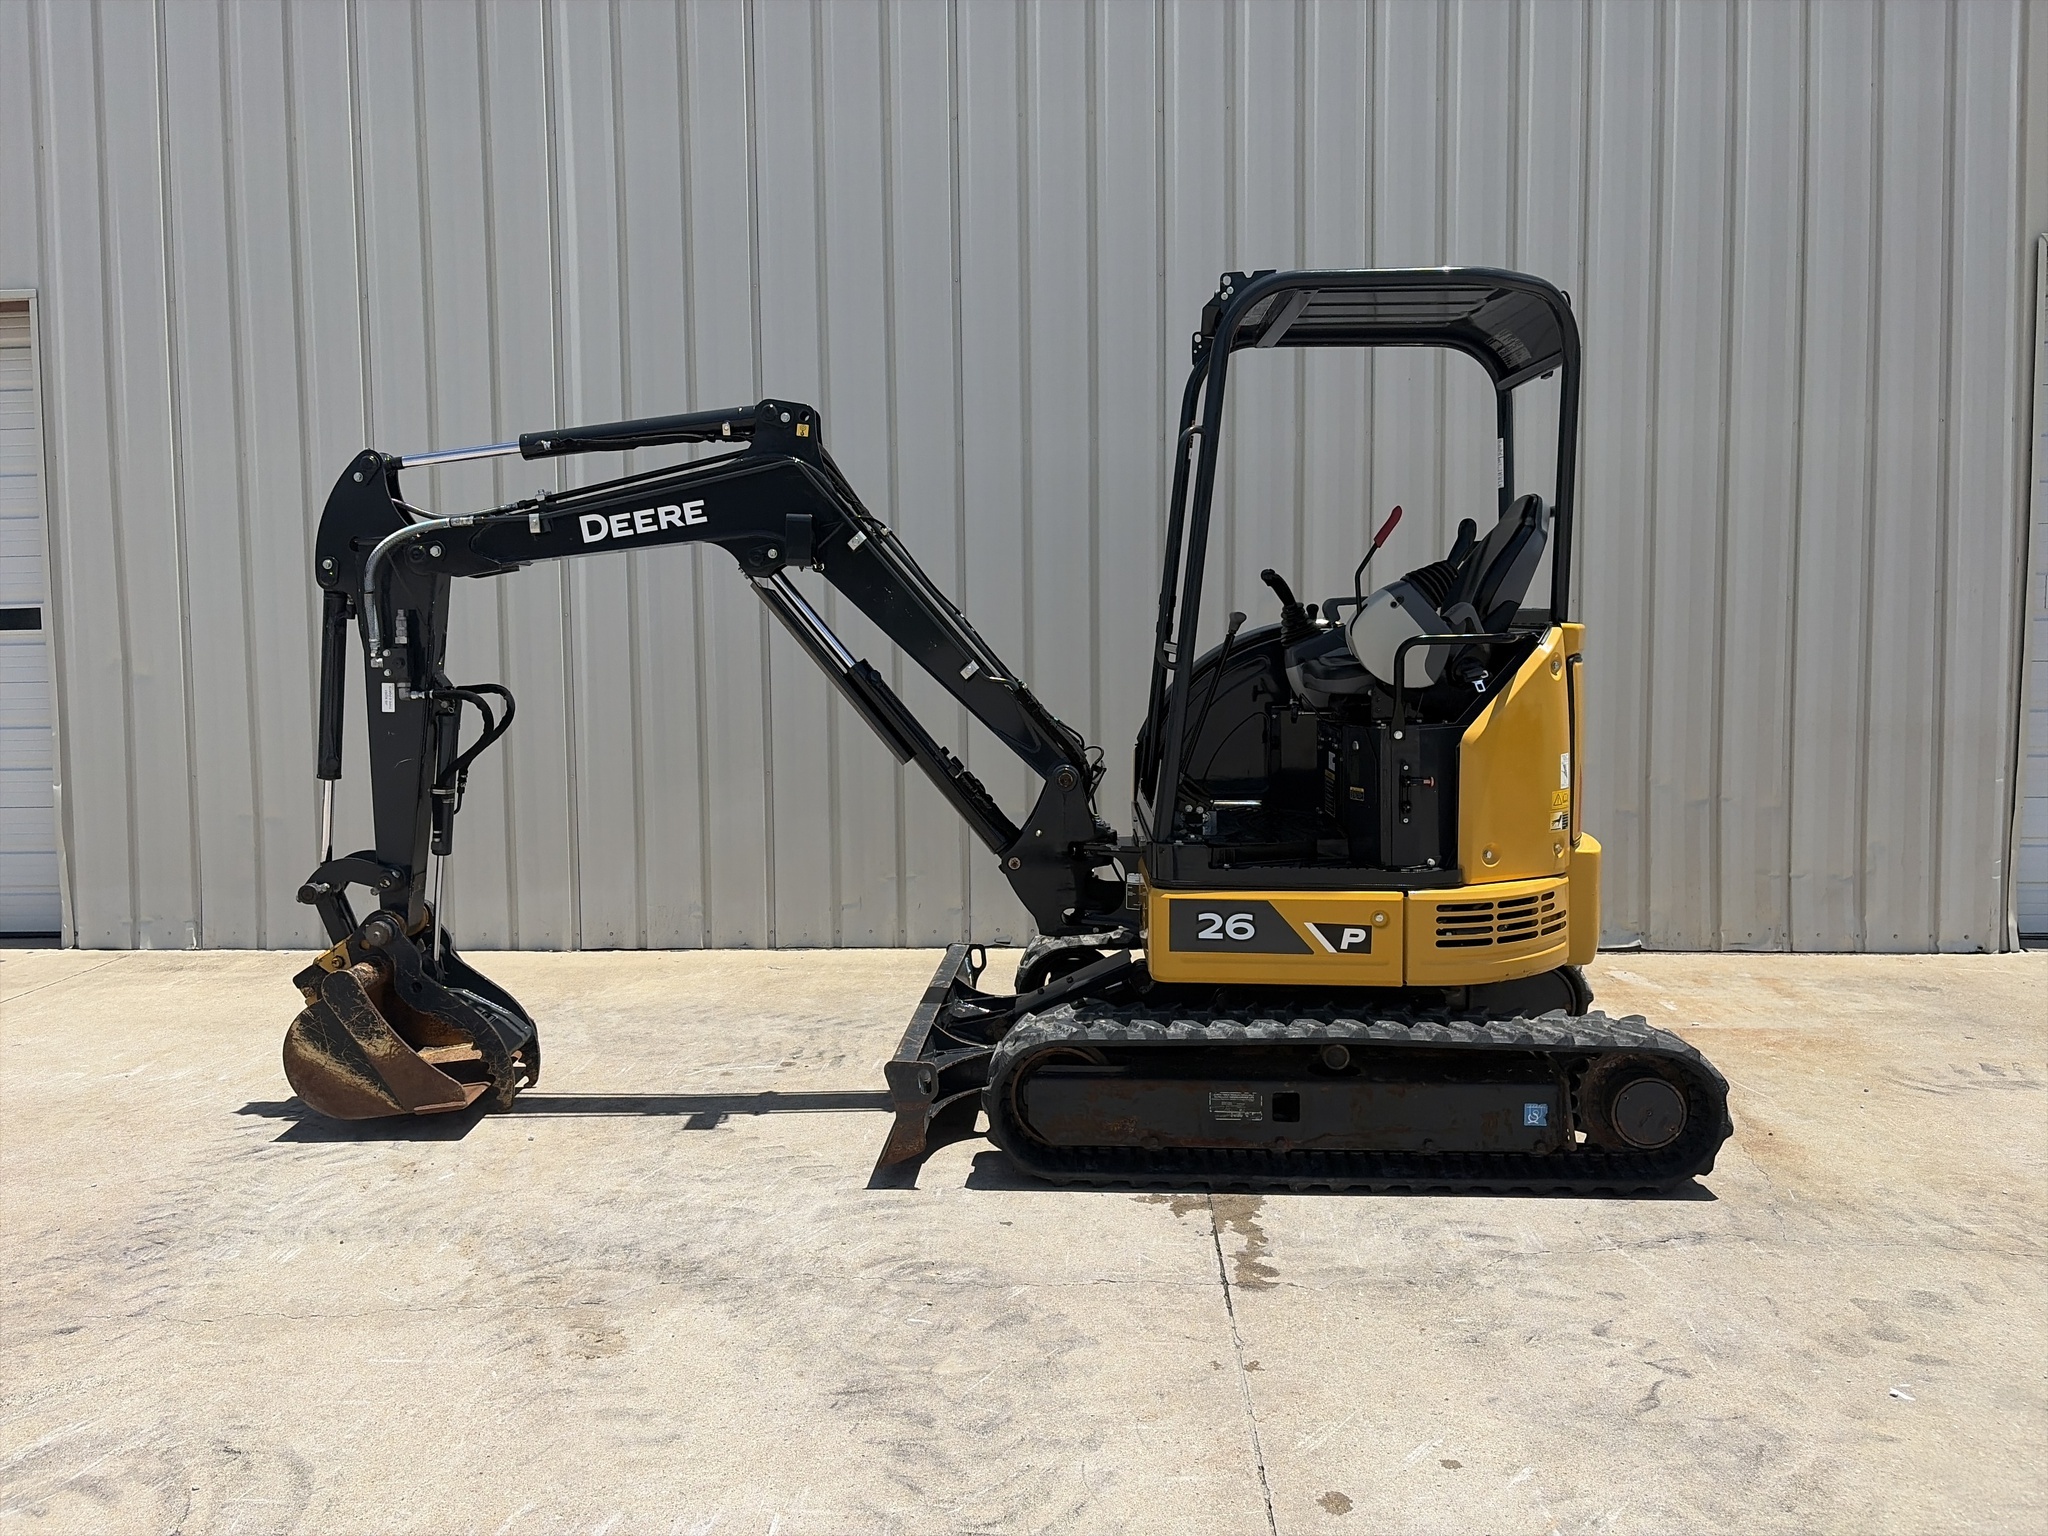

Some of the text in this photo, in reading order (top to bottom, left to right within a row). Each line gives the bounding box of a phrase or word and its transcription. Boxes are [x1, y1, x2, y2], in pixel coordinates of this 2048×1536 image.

[579, 500, 708, 543] DEERE
[1198, 912, 1256, 940] 26
[1340, 928, 1366, 950] P
